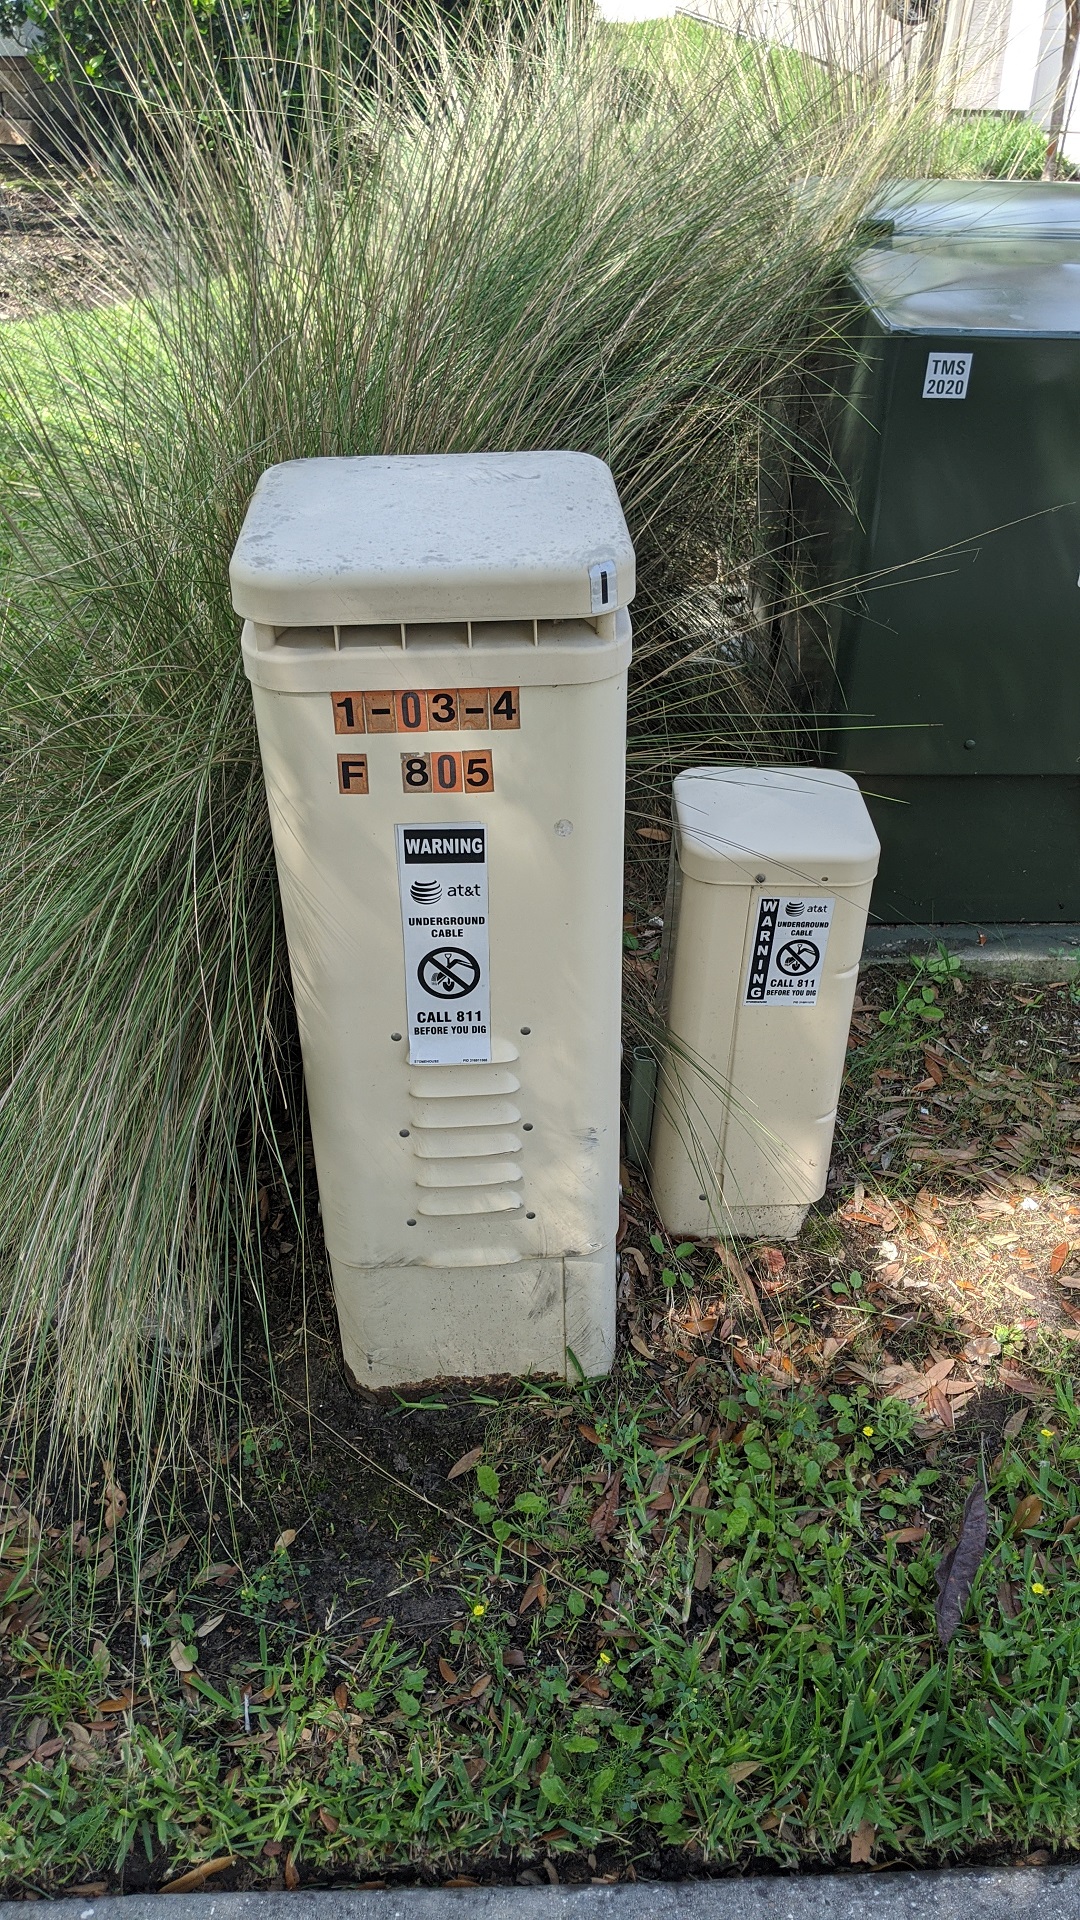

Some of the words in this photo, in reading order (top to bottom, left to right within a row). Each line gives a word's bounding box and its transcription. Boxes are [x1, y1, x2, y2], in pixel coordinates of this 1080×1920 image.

[932, 360, 966, 375] TMS
[926, 379, 964, 395] 2020
[336, 690, 517, 728] 1-03-4
[341, 760, 366, 789] F
[405, 755, 489, 789] 805
[405, 837, 484, 855] WARNING
[447, 883, 481, 897] at&t
[807, 904, 828, 913] at&t
[408, 916, 485, 926] UNDERGROUND
[431, 929, 464, 938] CABLE
[790, 929, 813, 937] CABLE
[750, 901, 778, 998] WARNING
[770, 979, 794, 988] CALL
[797, 979, 815, 988] 811
[416, 1011, 452, 1023] CALL
[456, 1010, 482, 1022] 811
[414, 1026, 448, 1035] BEFORE
[449, 1025, 470, 1035] YOU
[471, 1025, 486, 1034] DIG
